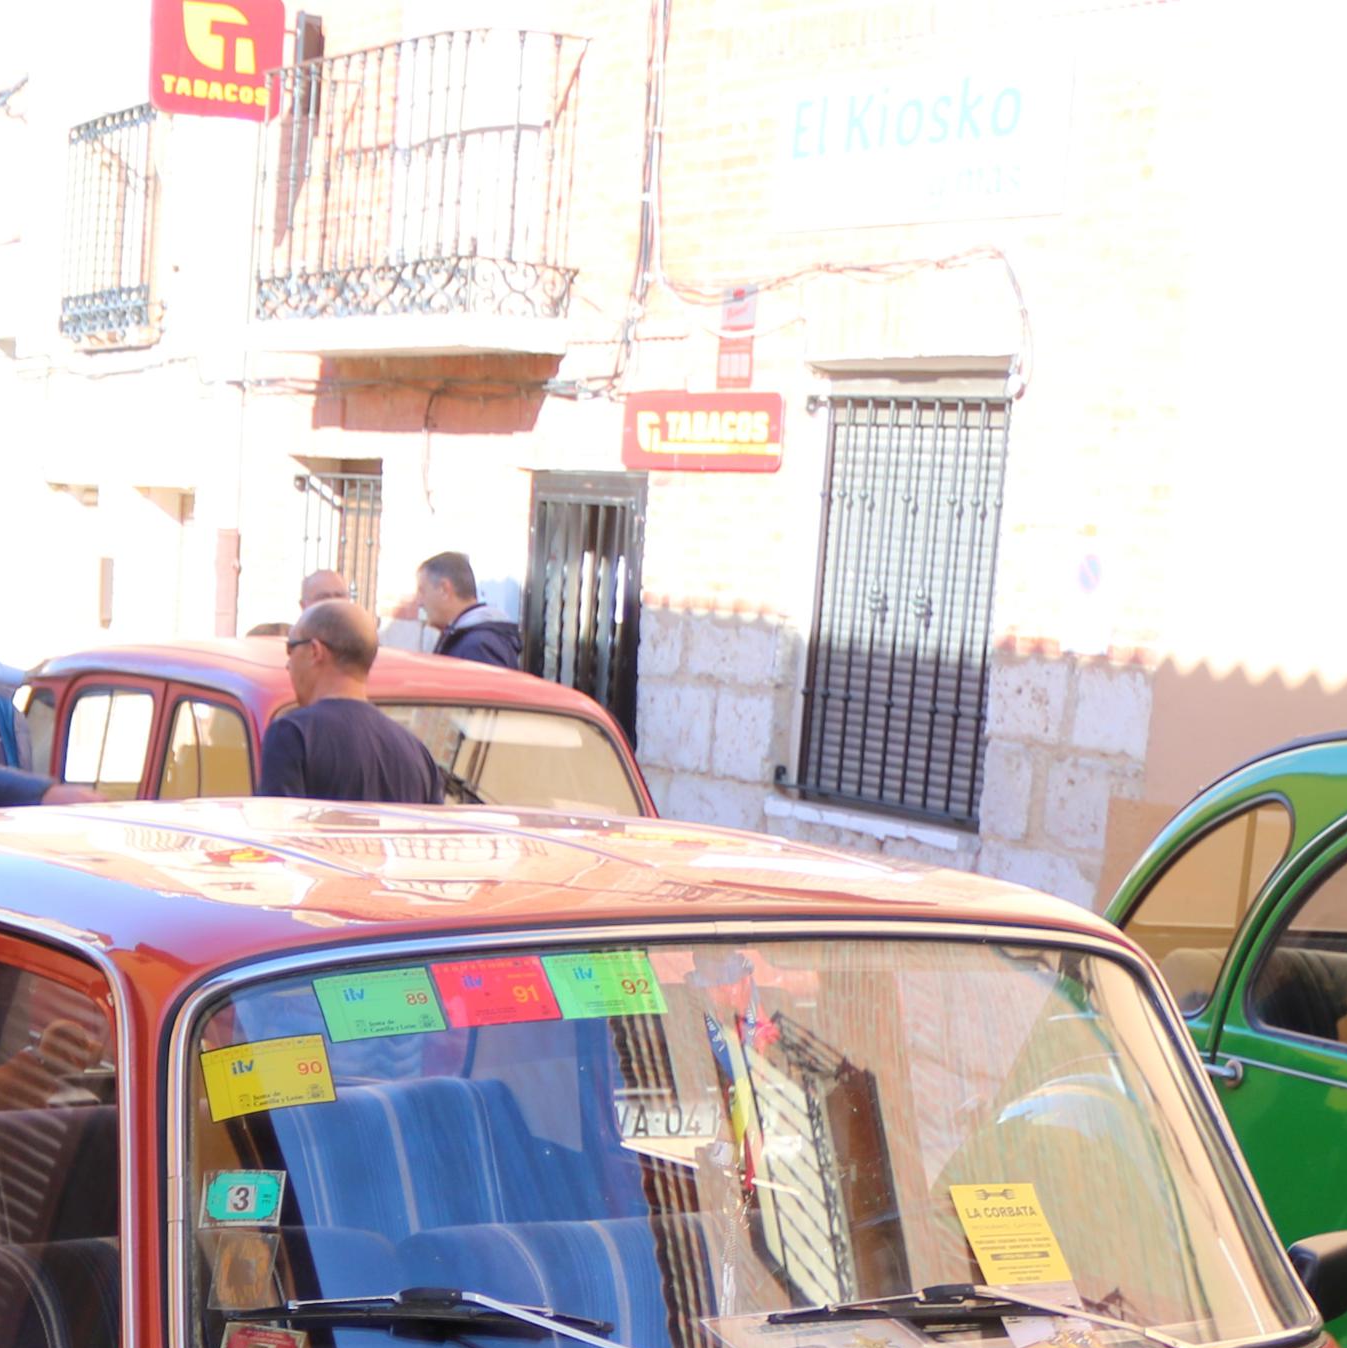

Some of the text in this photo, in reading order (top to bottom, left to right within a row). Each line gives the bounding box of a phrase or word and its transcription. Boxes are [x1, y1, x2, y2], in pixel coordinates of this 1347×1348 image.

[161, 73, 269, 107] TABACOS
[791, 73, 1023, 161] El Kiosko
[665, 410, 770, 443] TABACOS
[343, 986, 365, 1002] itv
[513, 983, 540, 1004] 91
[621, 978, 653, 996] 92
[405, 991, 429, 1005] 89
[232, 1059, 255, 1076] itv
[297, 1060, 324, 1076] 90
[232, 1186, 250, 1212] 3
[965, 1205, 1038, 1219] LA CORBATA
